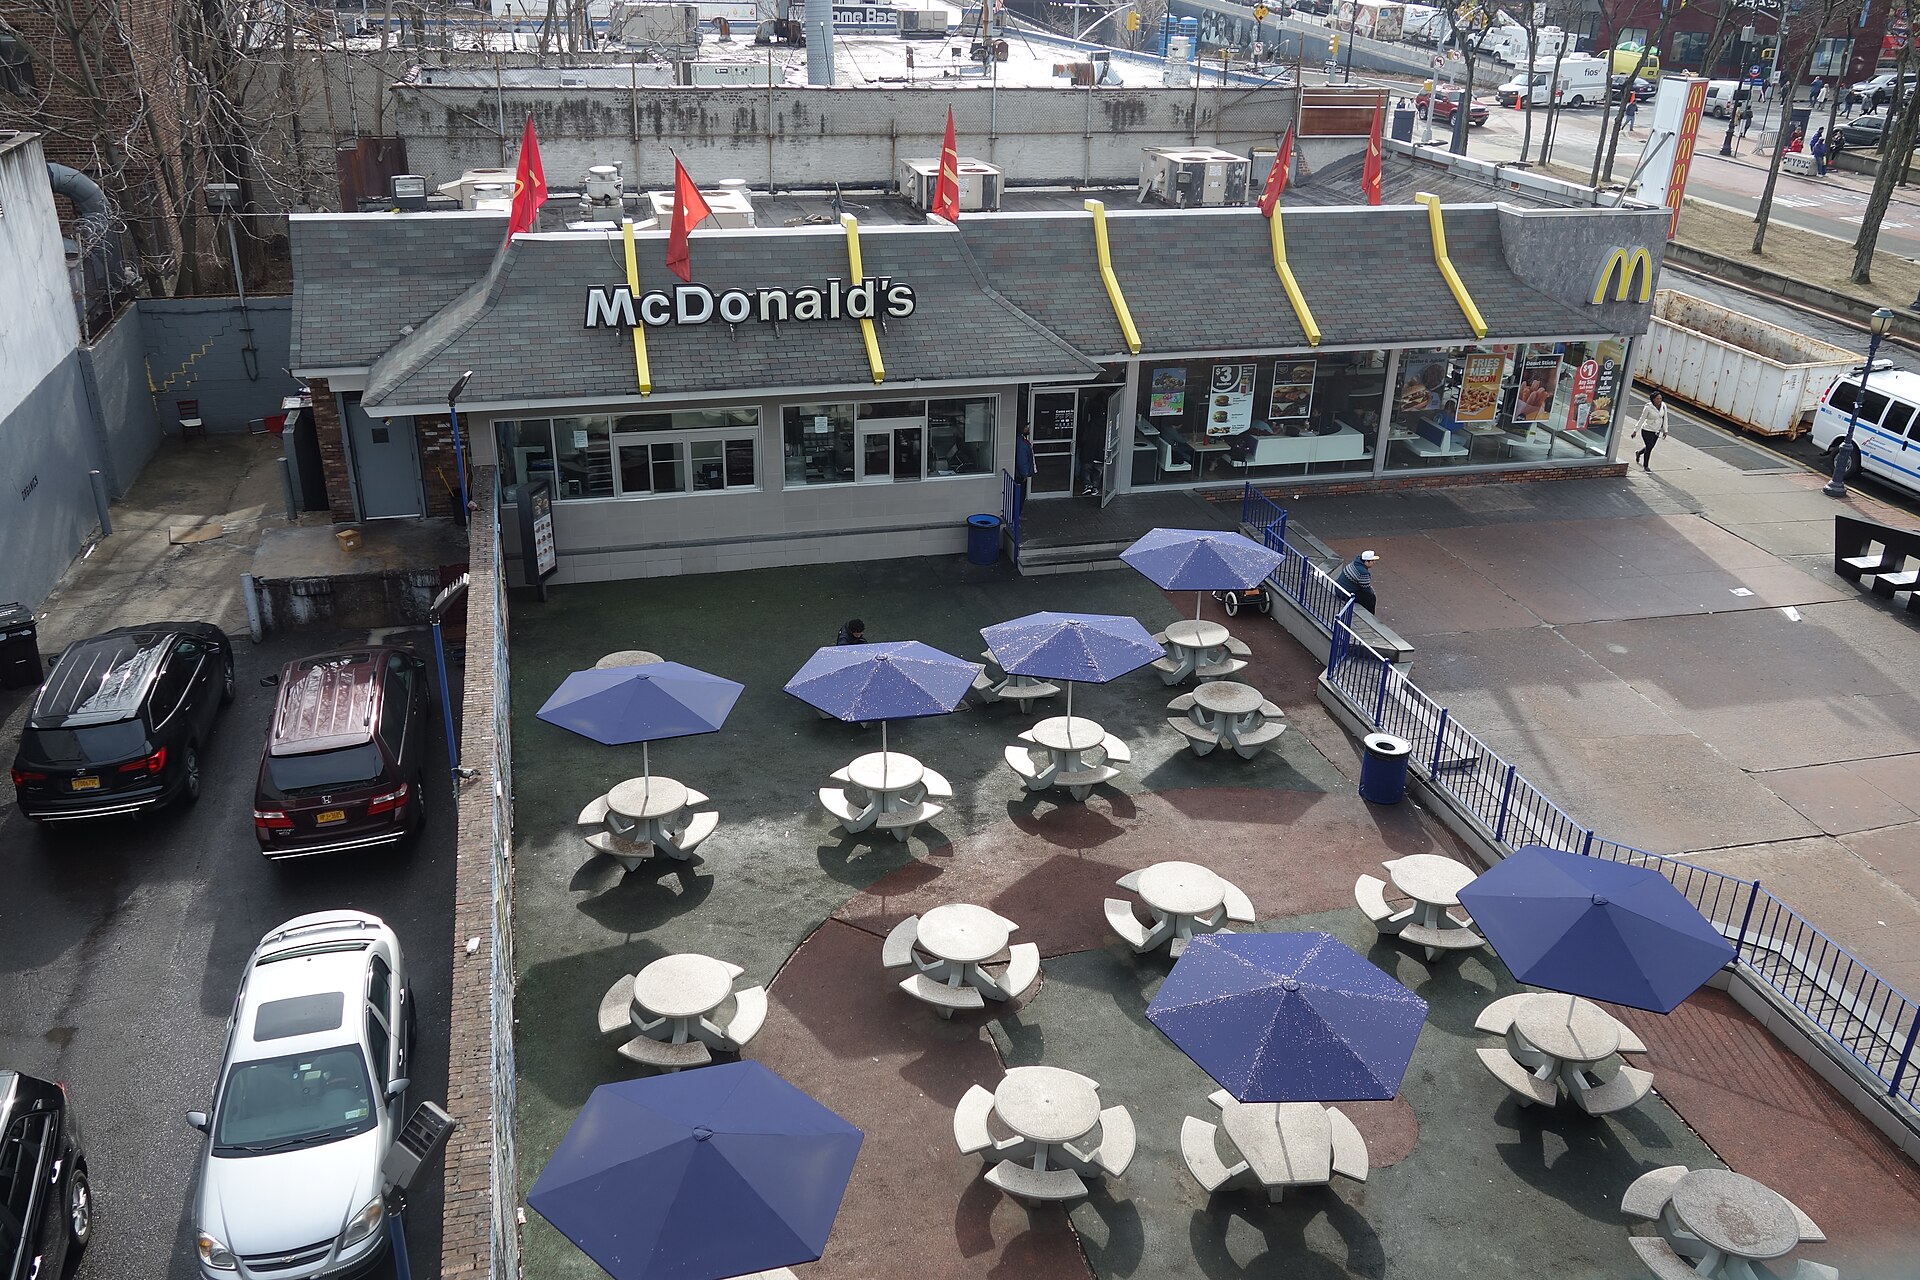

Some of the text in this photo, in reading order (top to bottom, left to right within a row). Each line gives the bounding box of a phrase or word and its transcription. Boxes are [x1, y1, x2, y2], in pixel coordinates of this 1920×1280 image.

[833, 8, 897, 22] ome Bas
[1584, 68, 1598, 76] fios
[585, 277, 916, 329] McDonald's
[1471, 358, 1500, 368] FRIES
[1216, 366, 1232, 382] $3
[1470, 367, 1498, 376] MEET
[1583, 364, 1594, 376] $1
